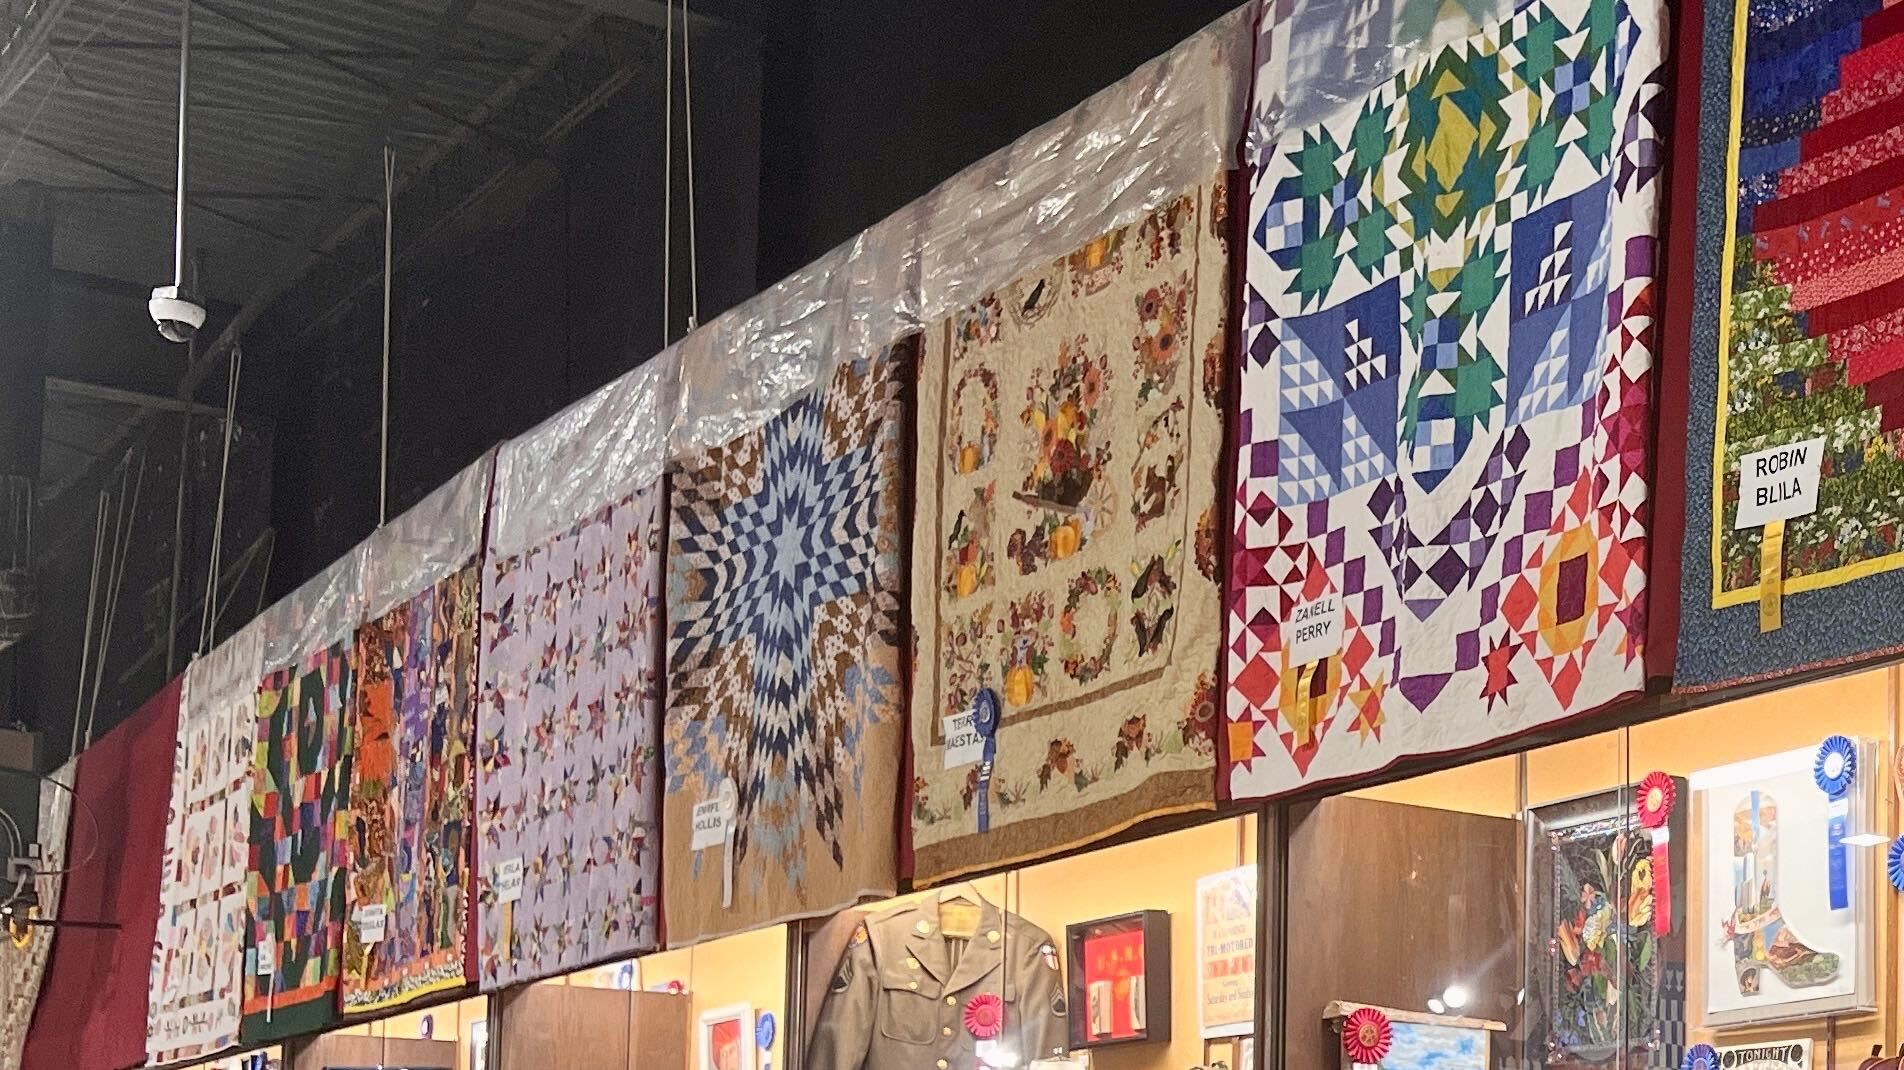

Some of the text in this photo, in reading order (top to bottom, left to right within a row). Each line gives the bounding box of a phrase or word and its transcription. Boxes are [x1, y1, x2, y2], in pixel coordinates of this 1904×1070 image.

[1756, 447, 1807, 477] ROBIN
[1756, 477, 1801, 506] BLILA
[1296, 620, 1331, 645] PERRY
[1739, 1046, 1788, 1064] TONIGHT
